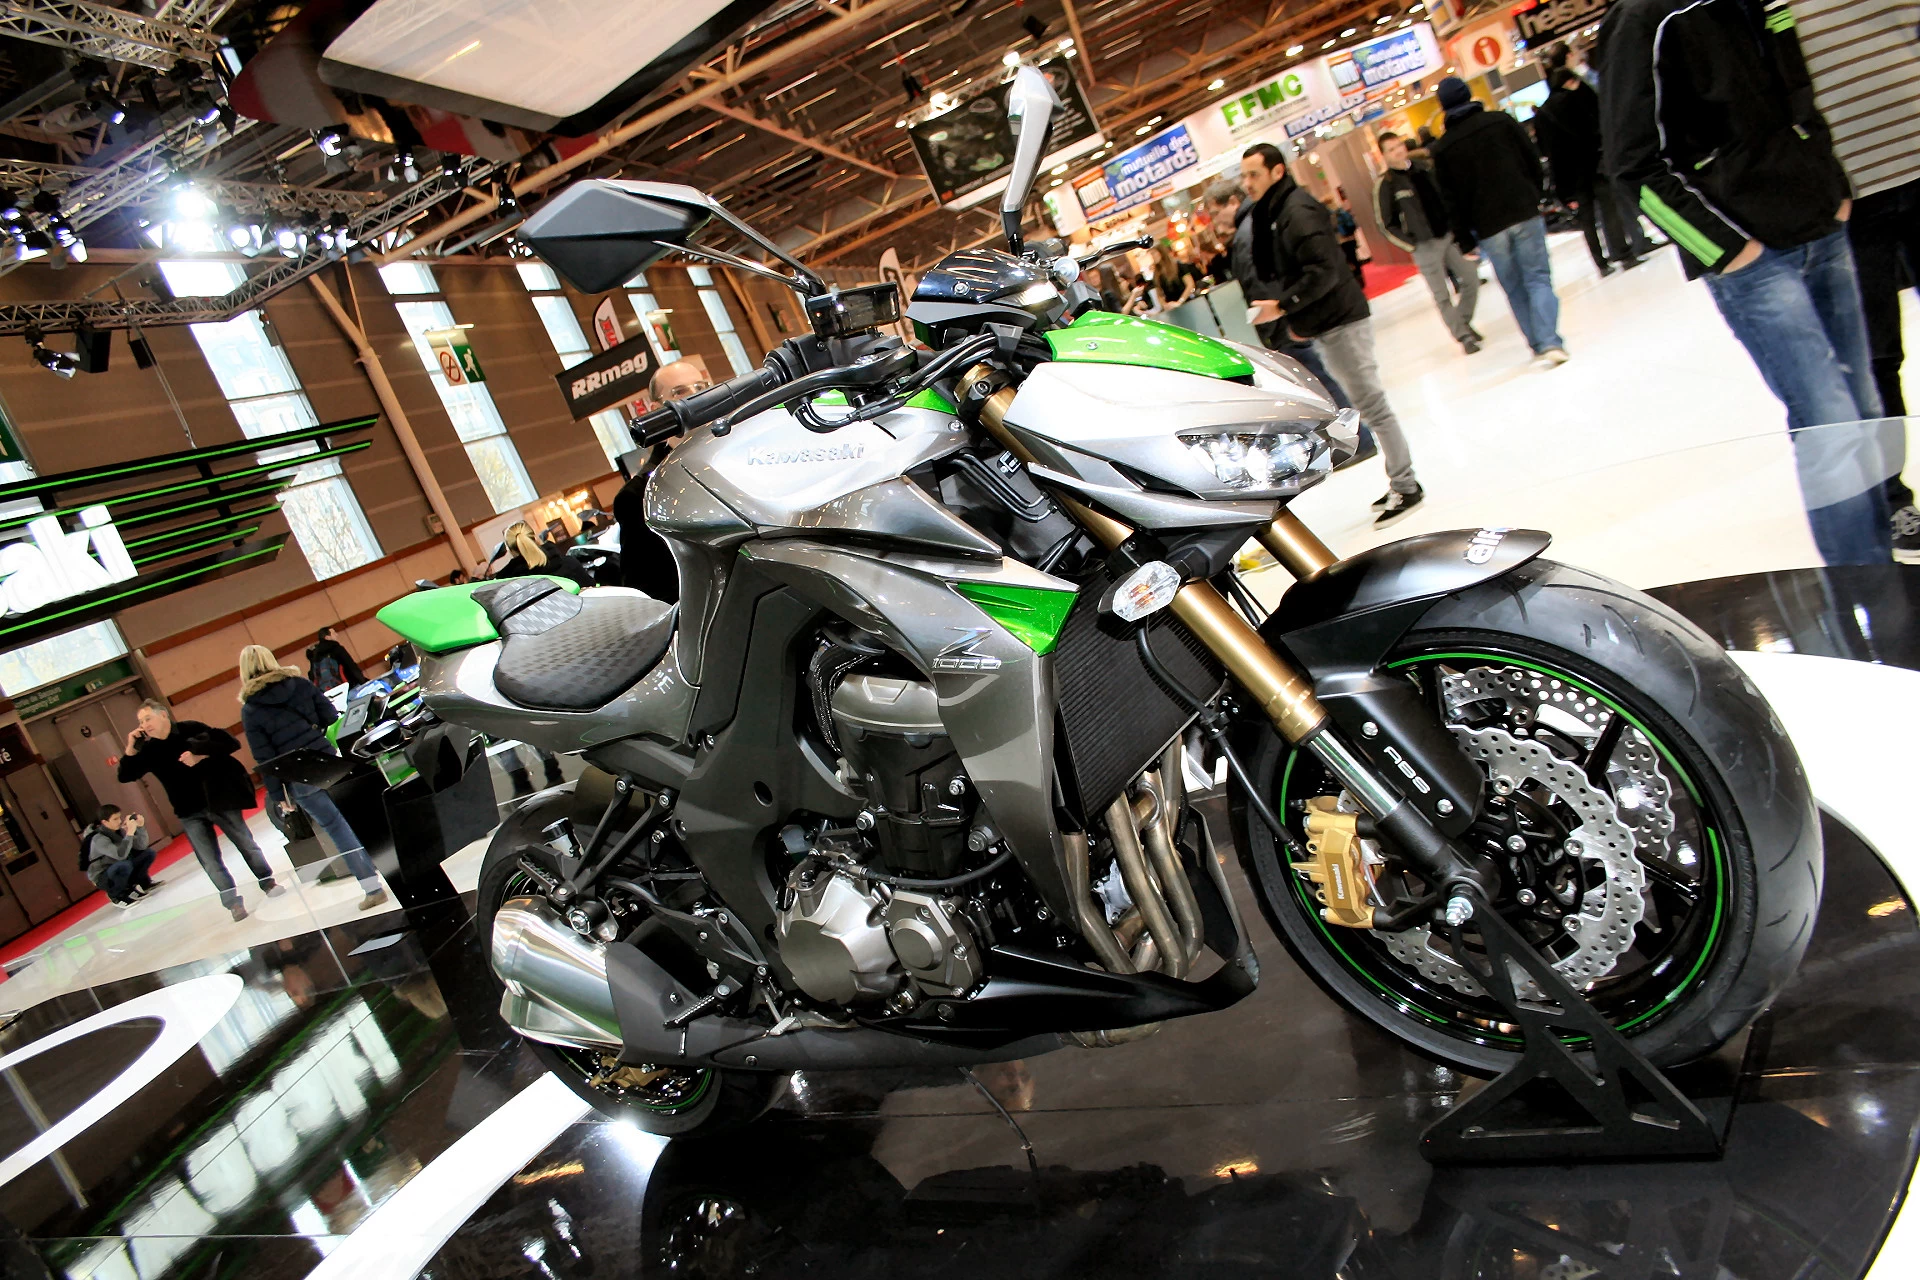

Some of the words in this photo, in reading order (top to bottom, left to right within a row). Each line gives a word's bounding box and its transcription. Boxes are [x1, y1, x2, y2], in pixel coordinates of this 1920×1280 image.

[1221, 74, 1303, 127] FFMC
[1114, 145, 1199, 199] motards
[1121, 144, 1169, 176] mutuelle
[571, 351, 648, 400] RRmag
[747, 443, 865, 466] Kawasaki
[932, 657, 1002, 670] 1000
[1383, 745, 1431, 794] ABS
